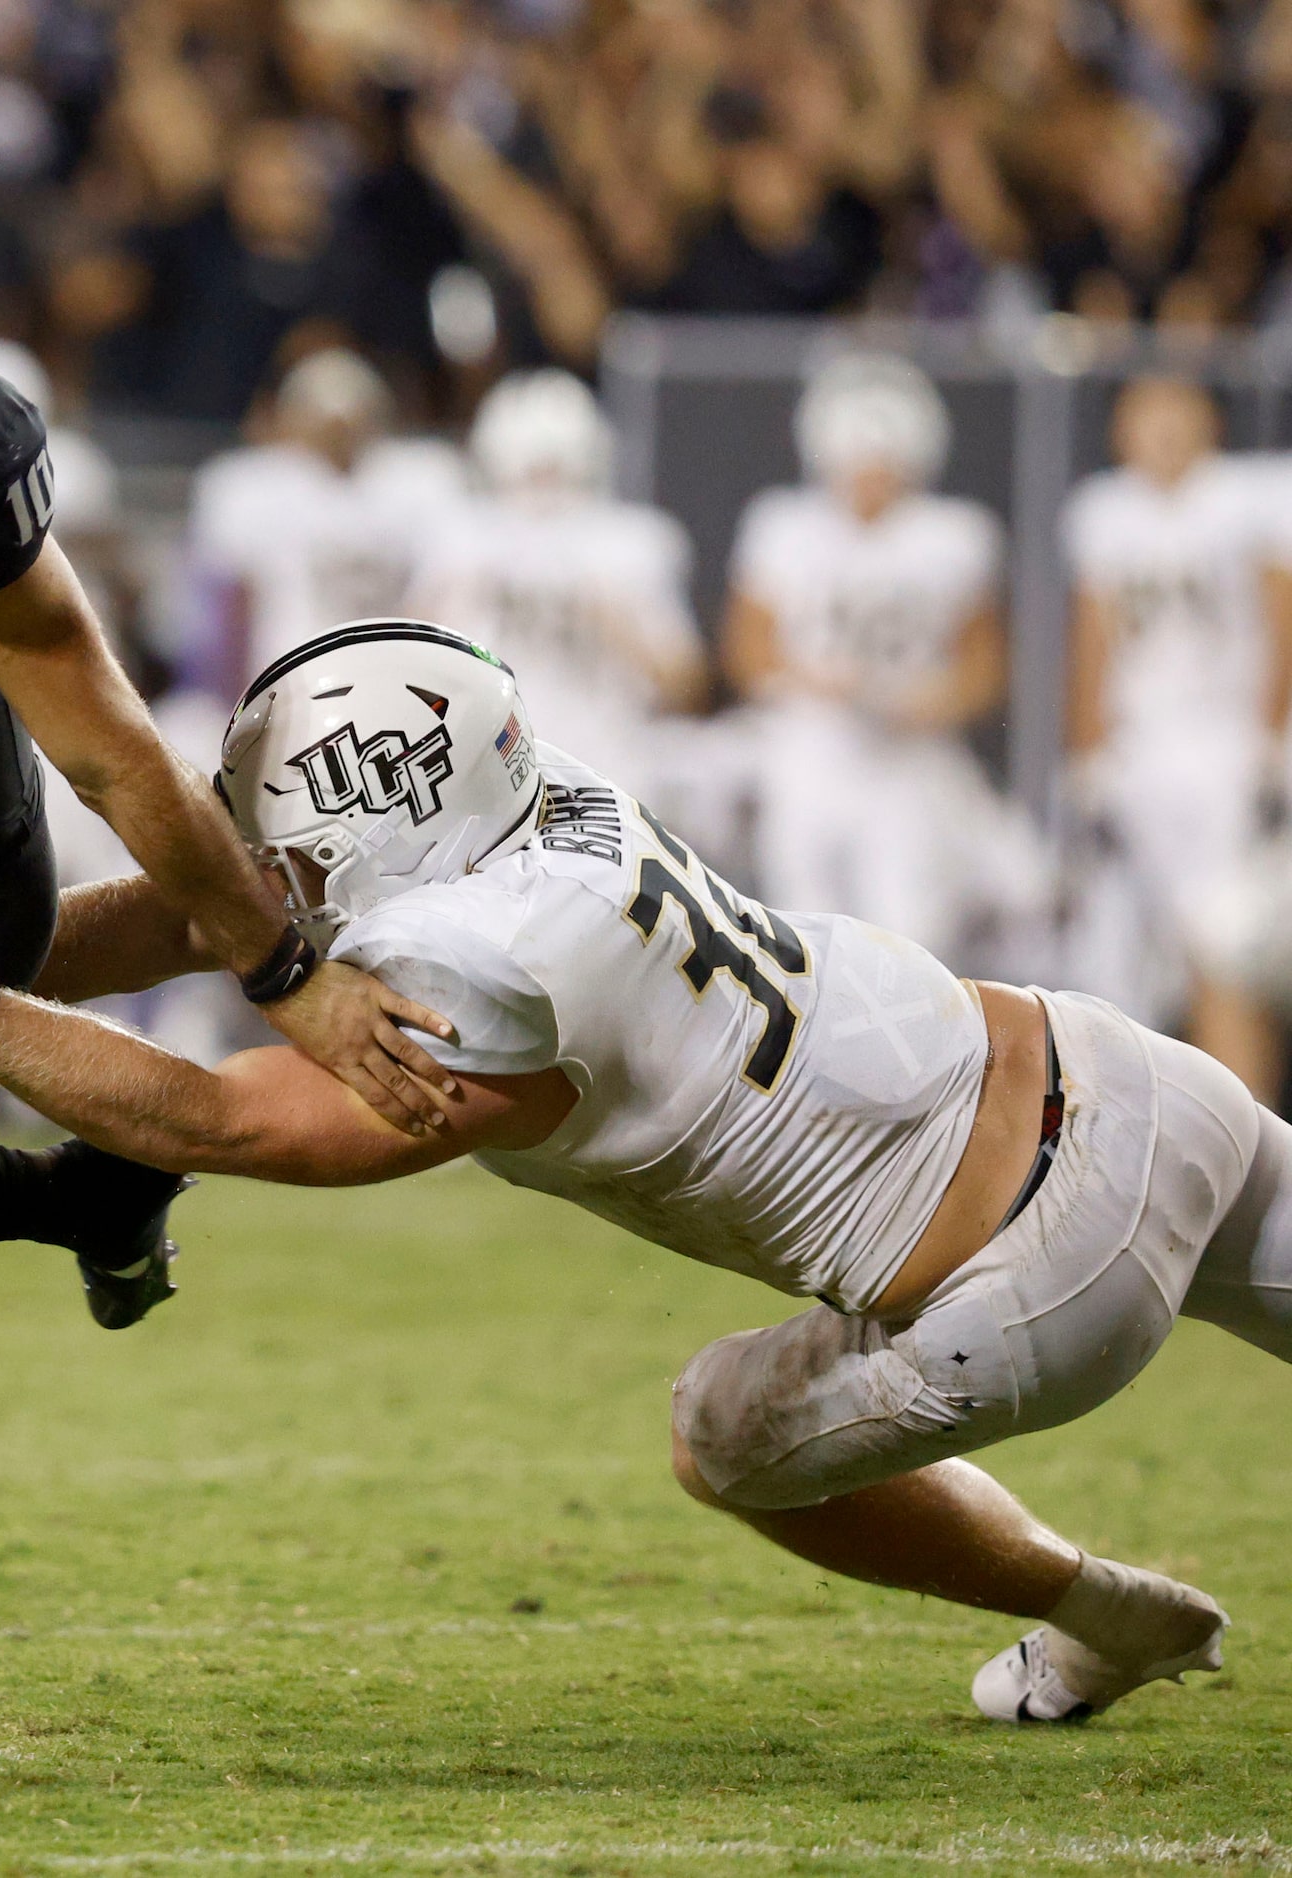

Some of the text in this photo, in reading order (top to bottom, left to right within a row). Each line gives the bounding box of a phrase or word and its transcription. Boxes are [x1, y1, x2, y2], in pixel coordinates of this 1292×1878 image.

[6, 448, 54, 546] 10
[284, 721, 454, 827] UCF
[620, 798, 811, 1098] 32
